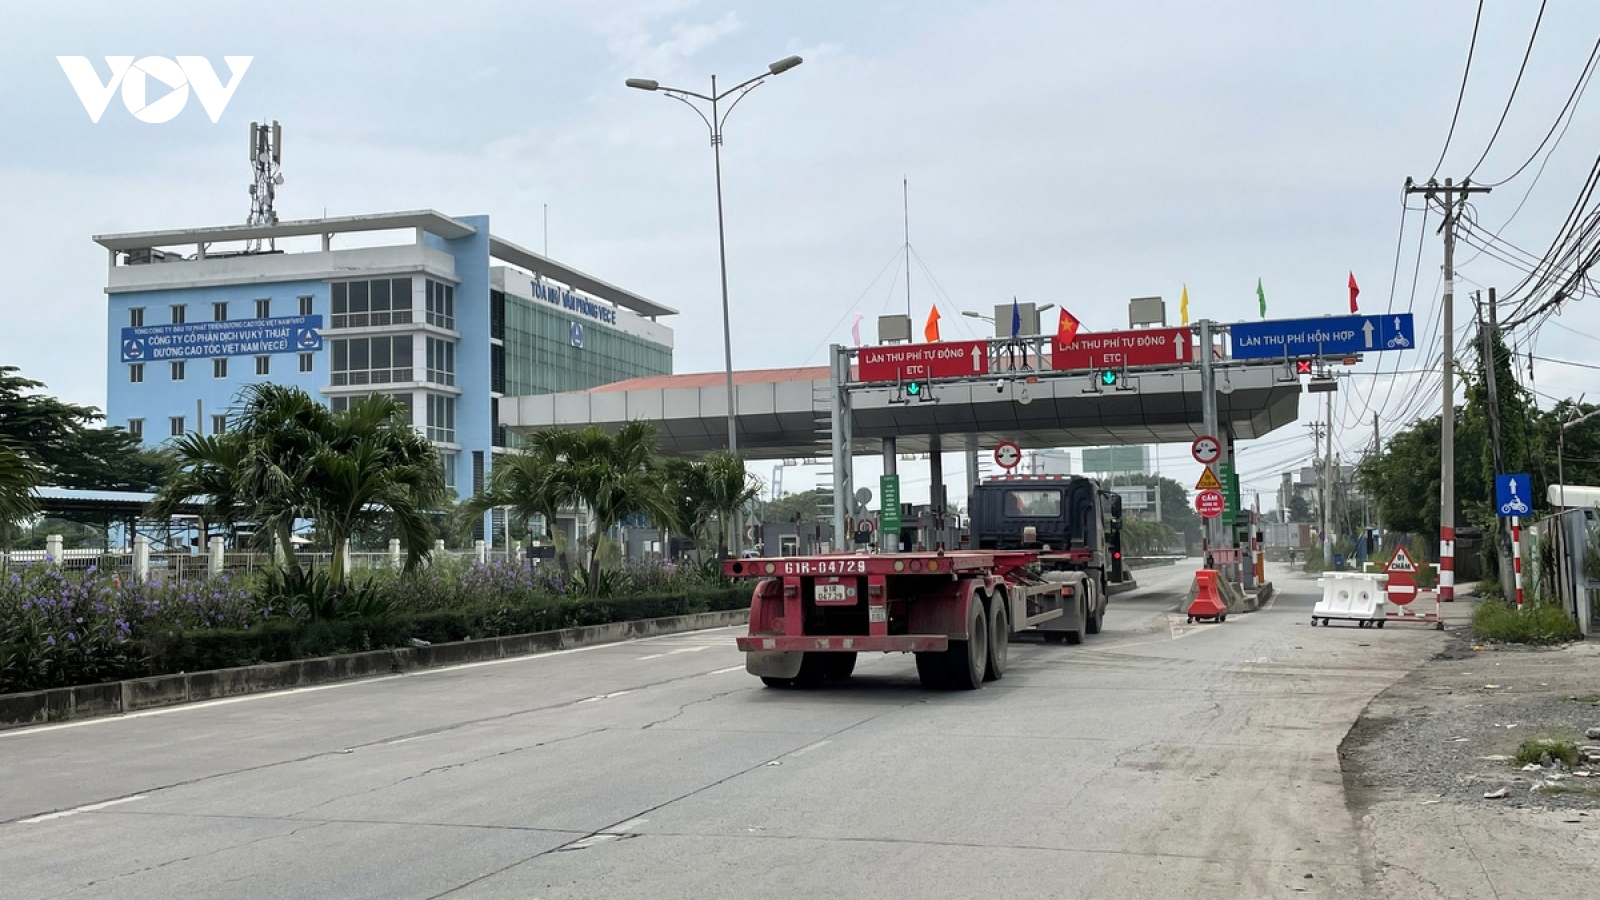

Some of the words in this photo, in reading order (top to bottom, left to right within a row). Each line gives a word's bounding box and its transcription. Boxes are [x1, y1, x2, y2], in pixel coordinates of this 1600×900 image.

[172, 334, 183, 344] TY
[1081, 340, 1101, 350] THU
[1103, 337, 1120, 348] PHÍ
[1123, 338, 1135, 348] TỰ
[1137, 335, 1166, 347] ĐỘNG
[1239, 335, 1261, 347] LÀN
[1263, 335, 1285, 345] THU
[1287, 333, 1304, 344] PHÍ
[1332, 331, 1355, 342] HỢP
[184, 346, 203, 355] CAO
[240, 341, 260, 352] NAM
[866, 353, 885, 363] LÀN
[886, 353, 904, 362] THU
[906, 350, 922, 361] PHÍ
[924, 350, 936, 360] TỰ
[938, 347, 964, 359] ĐỘNG
[1103, 354, 1122, 363] ETC
[906, 366, 924, 374] ETC
